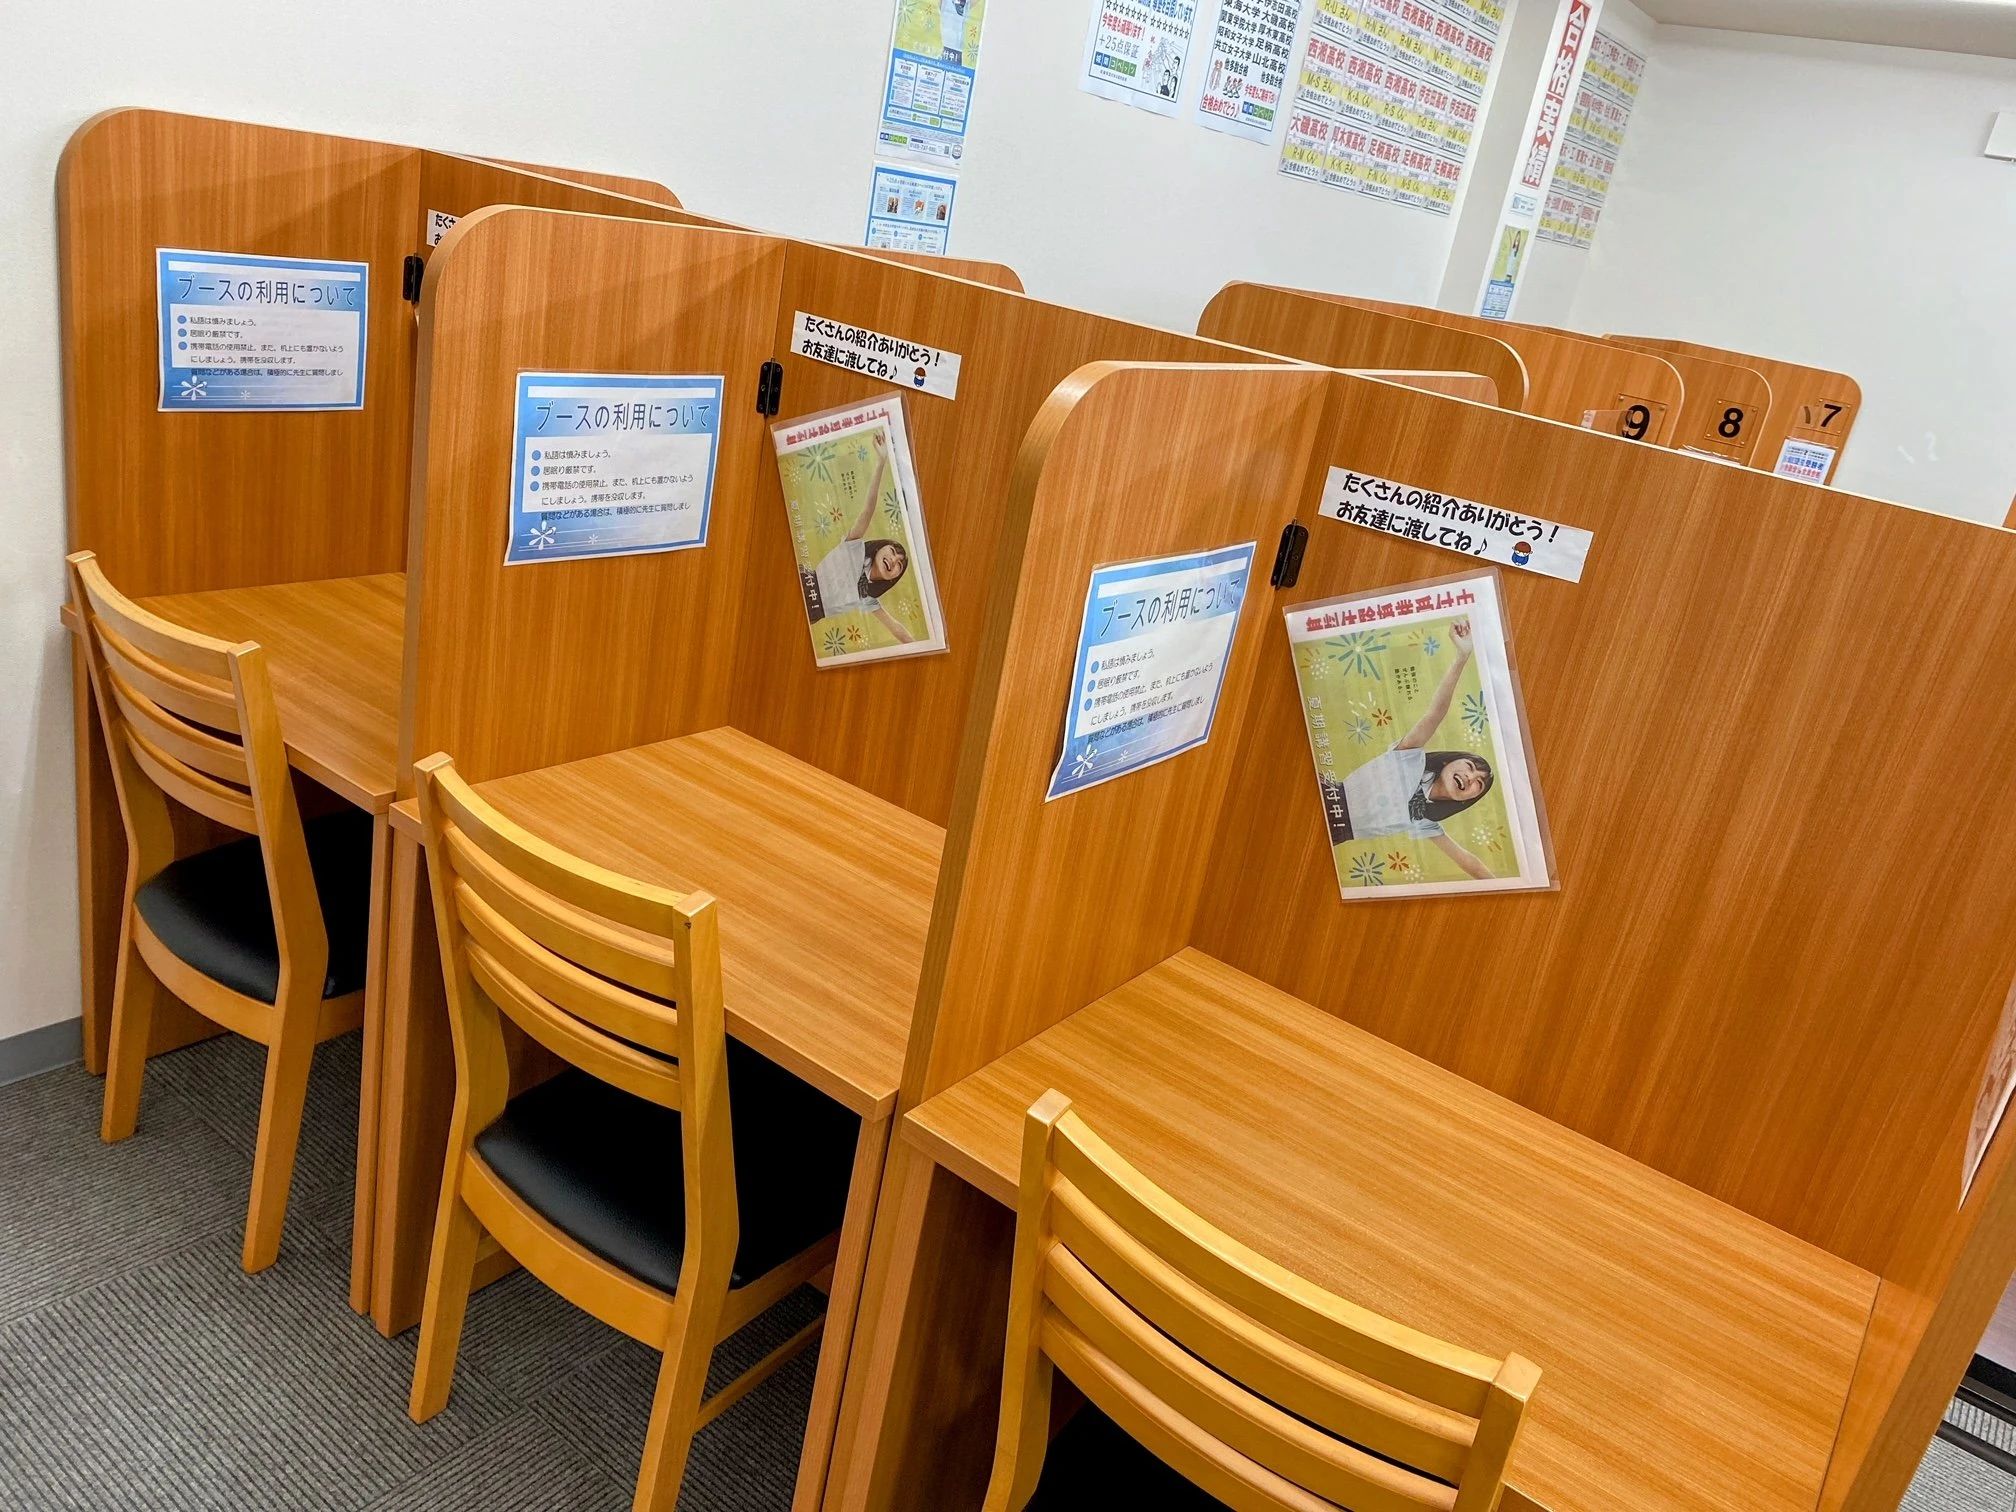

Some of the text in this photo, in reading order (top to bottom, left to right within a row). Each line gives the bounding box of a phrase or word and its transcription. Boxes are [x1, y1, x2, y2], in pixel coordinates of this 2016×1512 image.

[1217, 25, 1255, 48] 昭和女子大学
[1220, 9, 1257, 34] 関東学院大学
[1214, 39, 1252, 60] 共立女子大学
[1252, 53, 1286, 74] 山北高校
[1307, 38, 1346, 70] 西湘高校
[1347, 56, 1383, 85] 西湘高校
[1290, 112, 1329, 141] 大磯高校
[178, 274, 355, 306] ブースの利用について
[804, 316, 941, 367] たくさんの紹介ありがとう！
[802, 338, 898, 380] お友達に渡してね♪
[536, 401, 710, 431] ブースの利用について
[1622, 405, 1650, 440] 9
[1717, 407, 1744, 438] 8
[1820, 404, 1842, 427] 7
[1342, 473, 1561, 543] たくさんの紹介ありがとう！
[1336, 499, 1489, 556] お友達に渡してね♪
[1101, 579, 1240, 637] ブースの利用について
